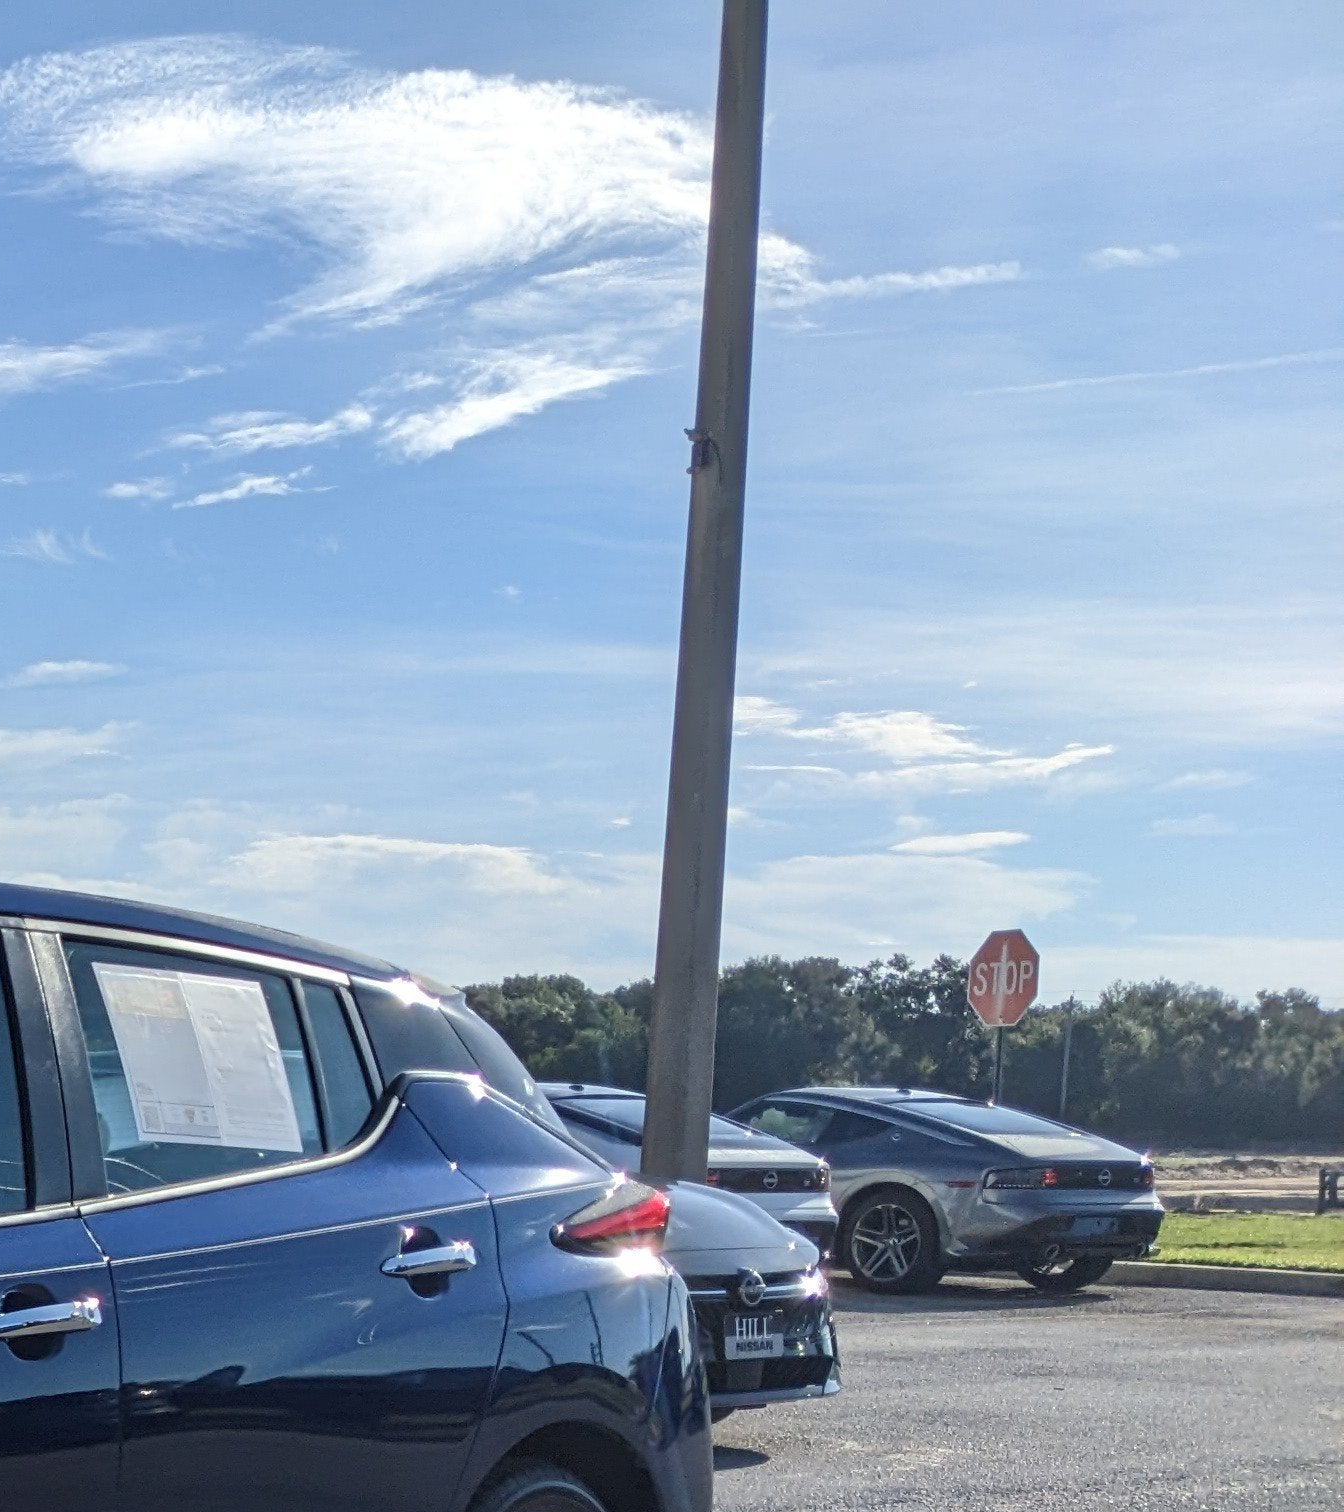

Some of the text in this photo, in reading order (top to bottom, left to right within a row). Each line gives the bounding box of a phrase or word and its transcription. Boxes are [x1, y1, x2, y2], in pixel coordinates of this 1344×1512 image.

[973, 960, 1034, 996] STOP
[734, 1315, 774, 1340] HILL
[735, 1340, 774, 1352] NISSAN
